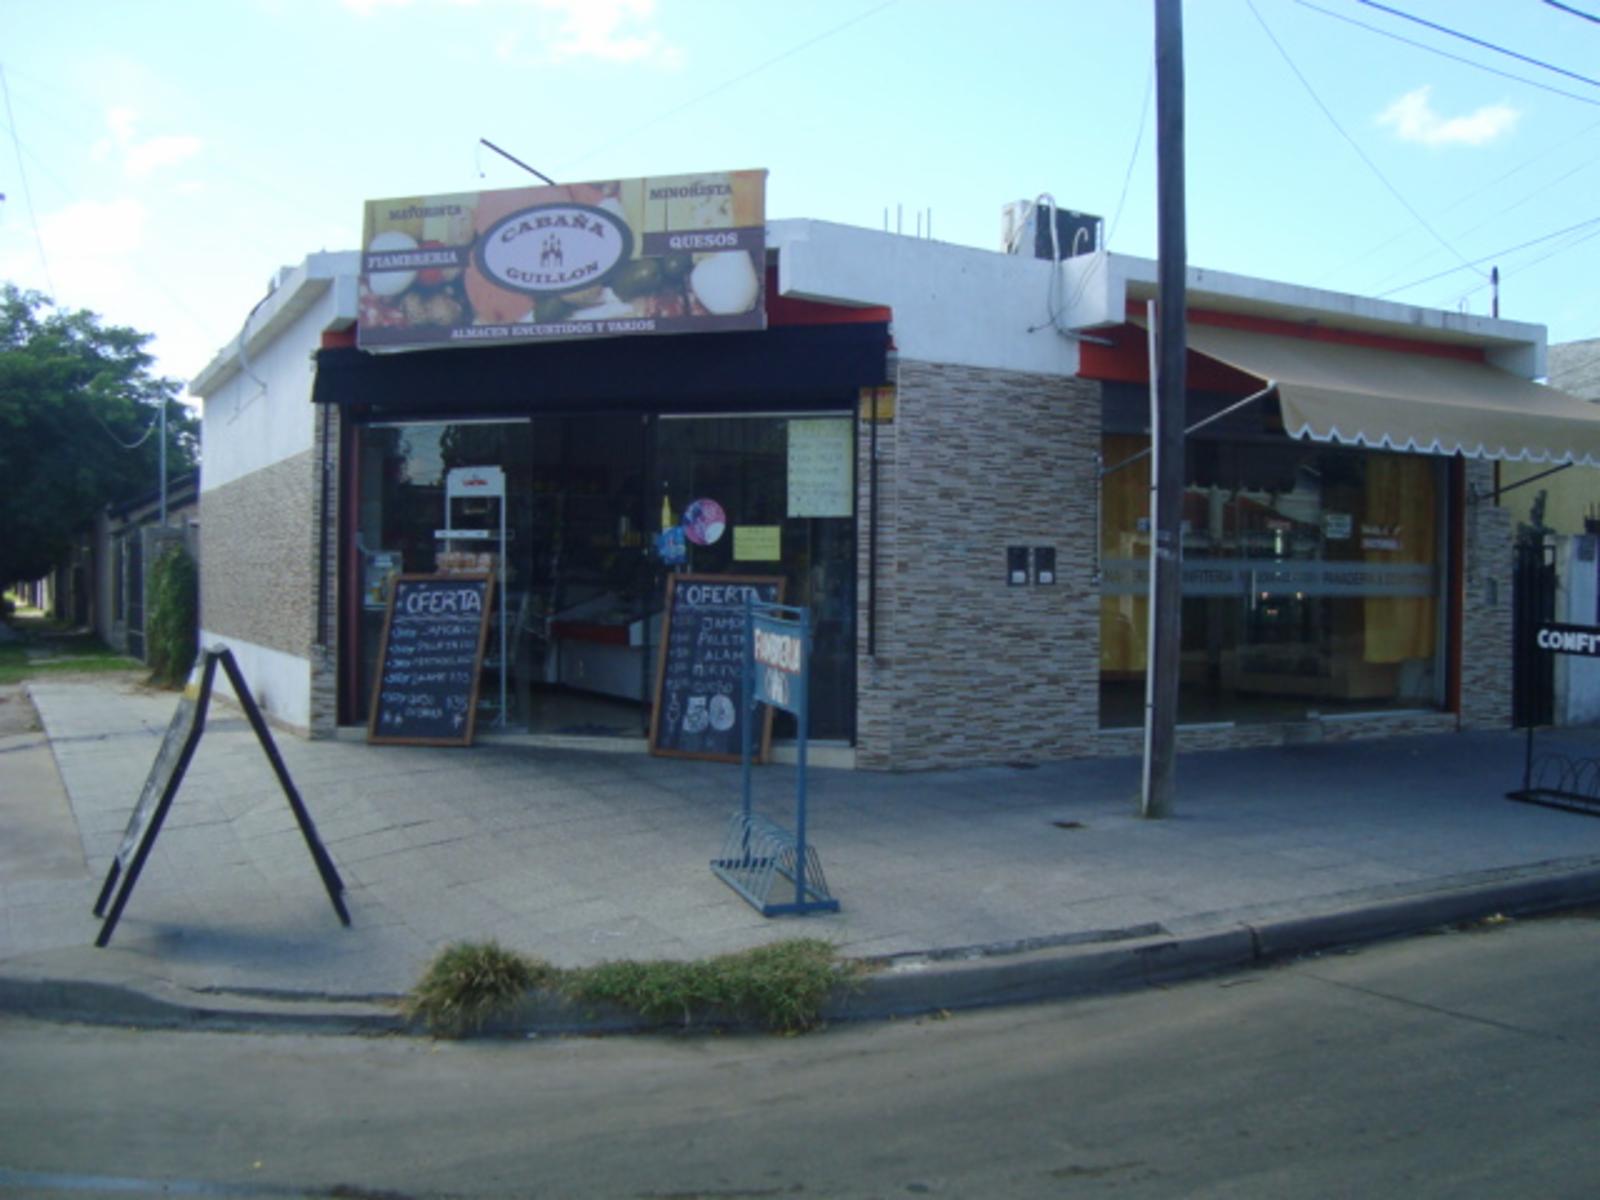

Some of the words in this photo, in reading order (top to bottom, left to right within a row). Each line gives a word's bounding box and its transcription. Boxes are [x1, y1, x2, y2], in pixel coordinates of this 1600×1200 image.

[649, 183, 733, 201] MINORISTA
[500, 212, 606, 245] CABAÑA
[669, 232, 739, 249] QUESOS
[367, 250, 458, 269] FIAMBRERIA
[504, 261, 600, 285] GUILLON
[450, 324, 508, 339] ALMACEN
[595, 321, 606, 334] Y
[608, 319, 656, 333] VARIOS
[406, 589, 482, 614] OFERTA
